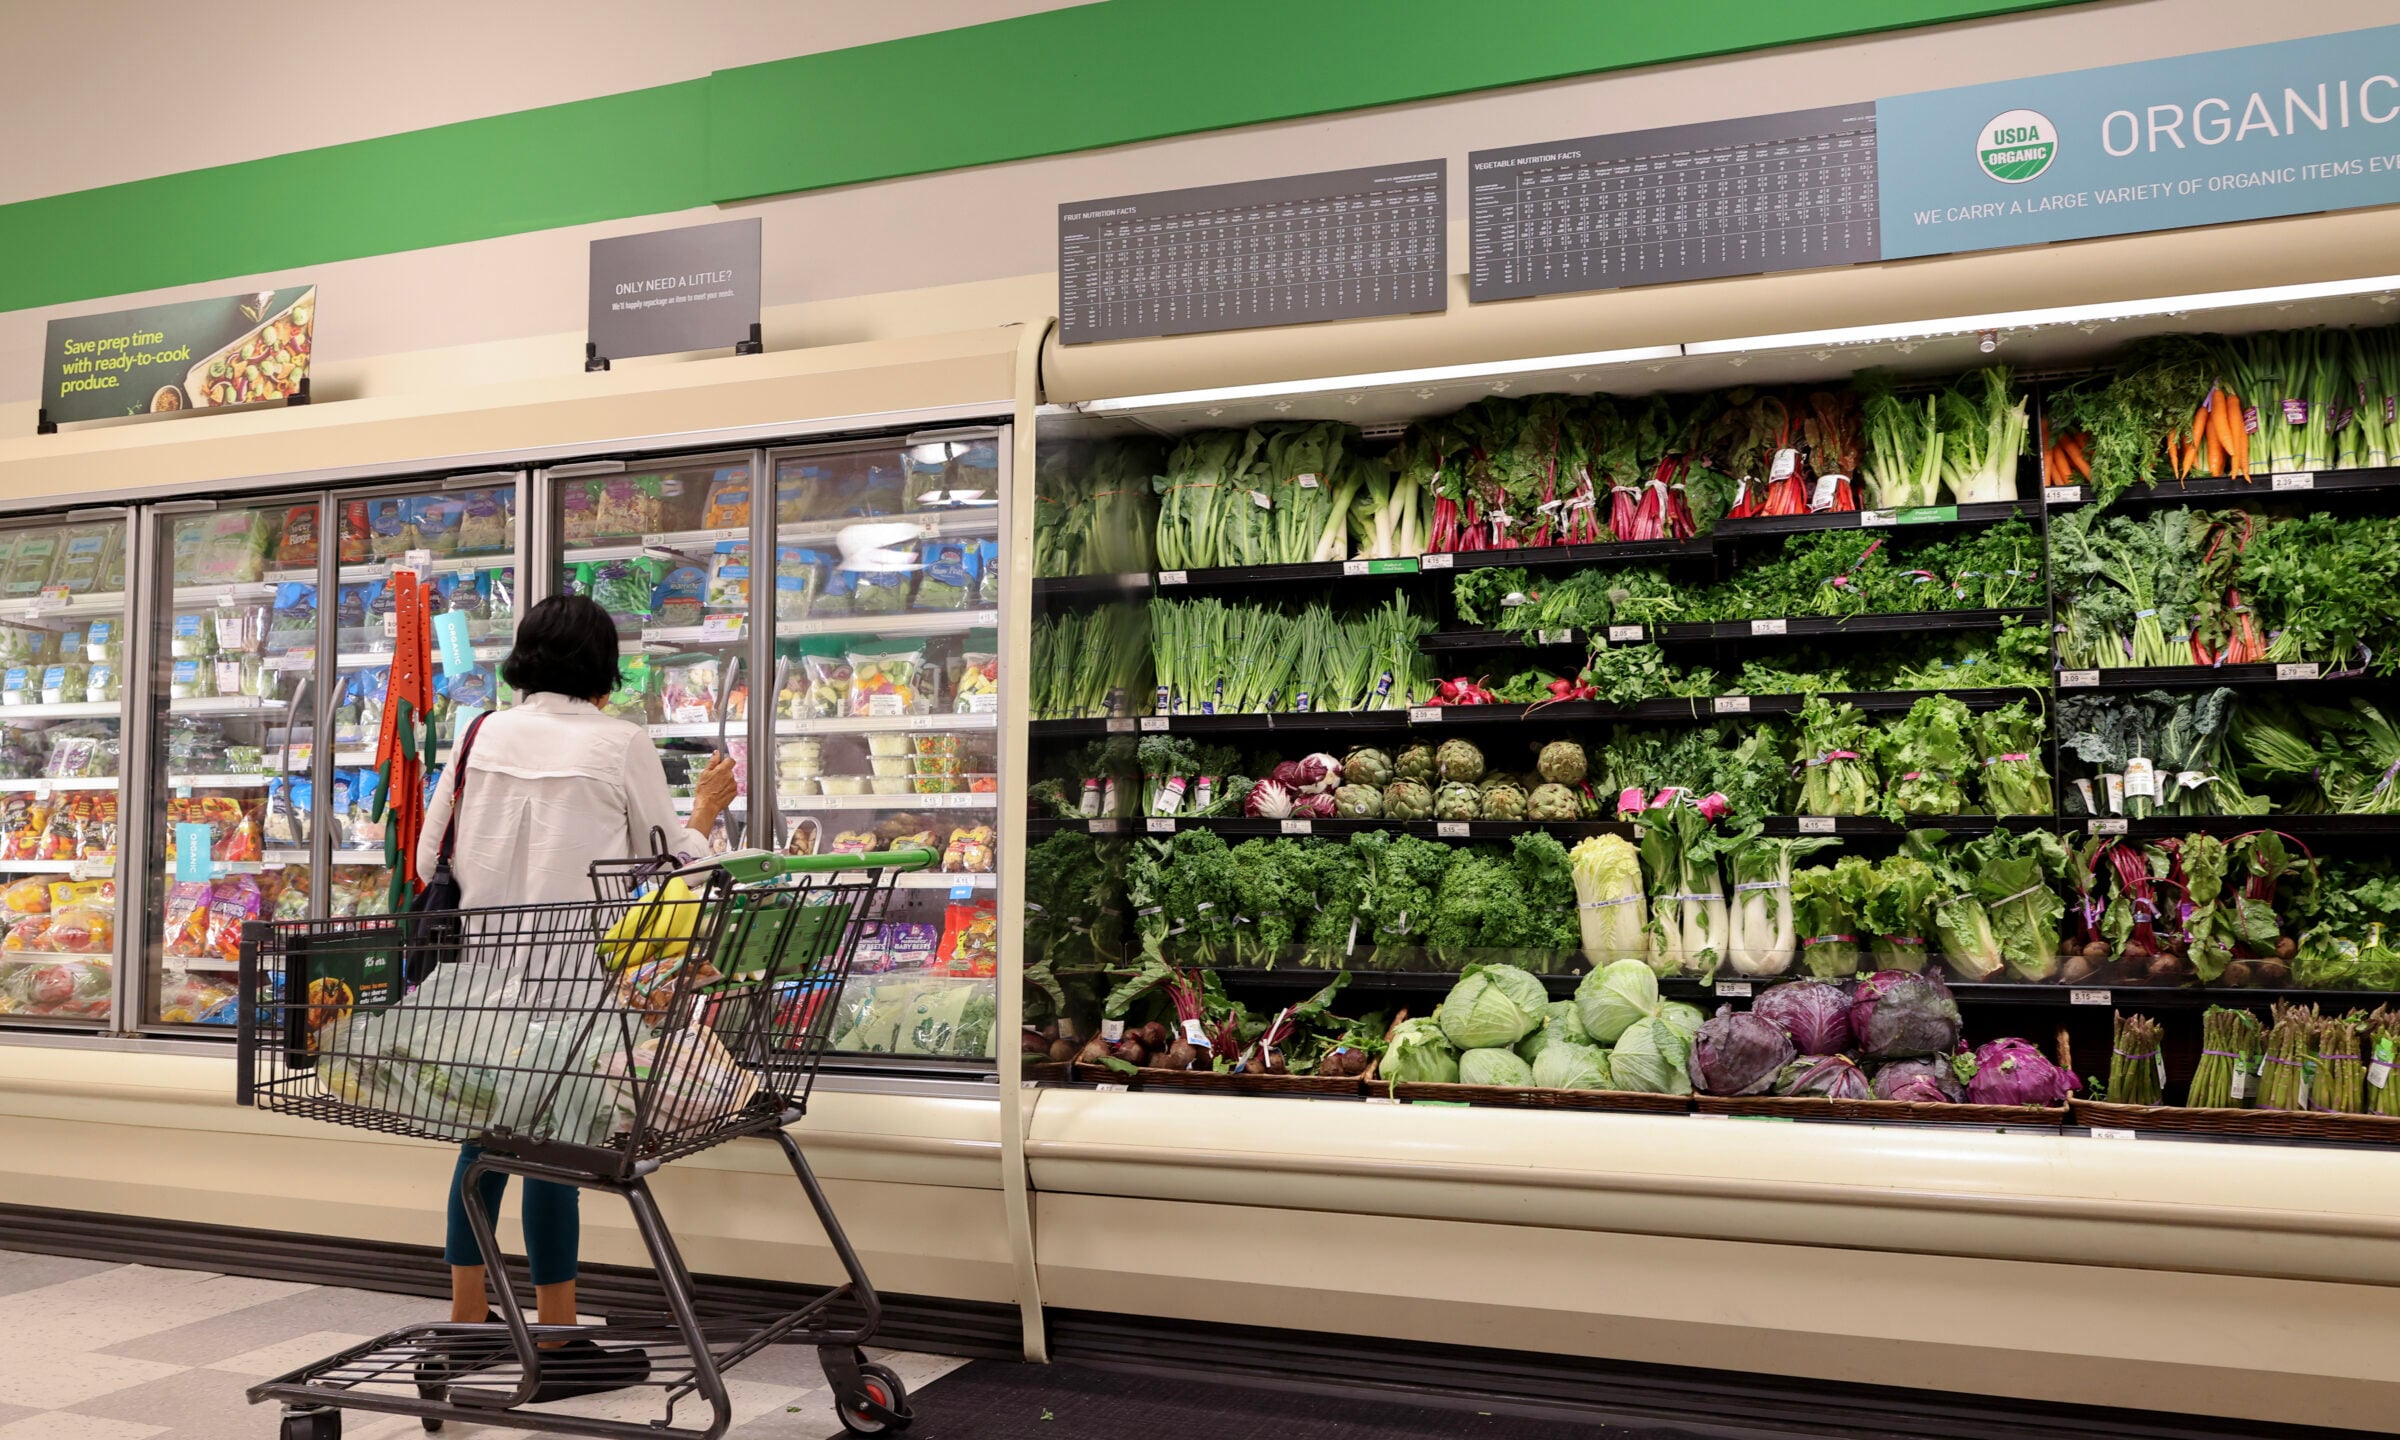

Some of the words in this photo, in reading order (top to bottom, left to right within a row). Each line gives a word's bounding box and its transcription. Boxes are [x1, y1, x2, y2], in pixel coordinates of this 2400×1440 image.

[2102, 75, 2400, 157] ORGANIC
[1994, 125, 2040, 146] USDA
[1474, 159, 1516, 171] VEGETABLE
[1517, 154, 1556, 165] NUTRITION
[1557, 151, 1582, 161] FACTS
[1989, 147, 2047, 166] ORGANIC
[1914, 209, 1942, 225] WE
[1947, 202, 2005, 222] CARRY
[2010, 201, 2022, 214] A
[2027, 192, 2088, 213] LARGE
[2095, 182, 2173, 205] VARIETY
[2178, 178, 2202, 196] OF
[2208, 168, 2296, 192] ORGANIC
[2302, 159, 2364, 181] ITEMS
[1063, 213, 1082, 222] FRUIT
[1083, 209, 1116, 219] NUTRITION
[1116, 206, 1137, 215] FACTS
[615, 281, 644, 296] ONLY
[646, 277, 676, 291] NEED
[678, 276, 687, 288] A
[689, 270, 733, 286] LITTLE?
[64, 339, 96, 355] Save
[97, 337, 130, 356] prep
[131, 330, 164, 346] time
[62, 357, 92, 375] with
[95, 344, 190, 372] ready-to-cook
[61, 374, 119, 398] produce.
[447, 622, 461, 666] ORGANIC
[2281, 668, 2298, 677] 2.79
[189, 833, 198, 873] ORGANIC
